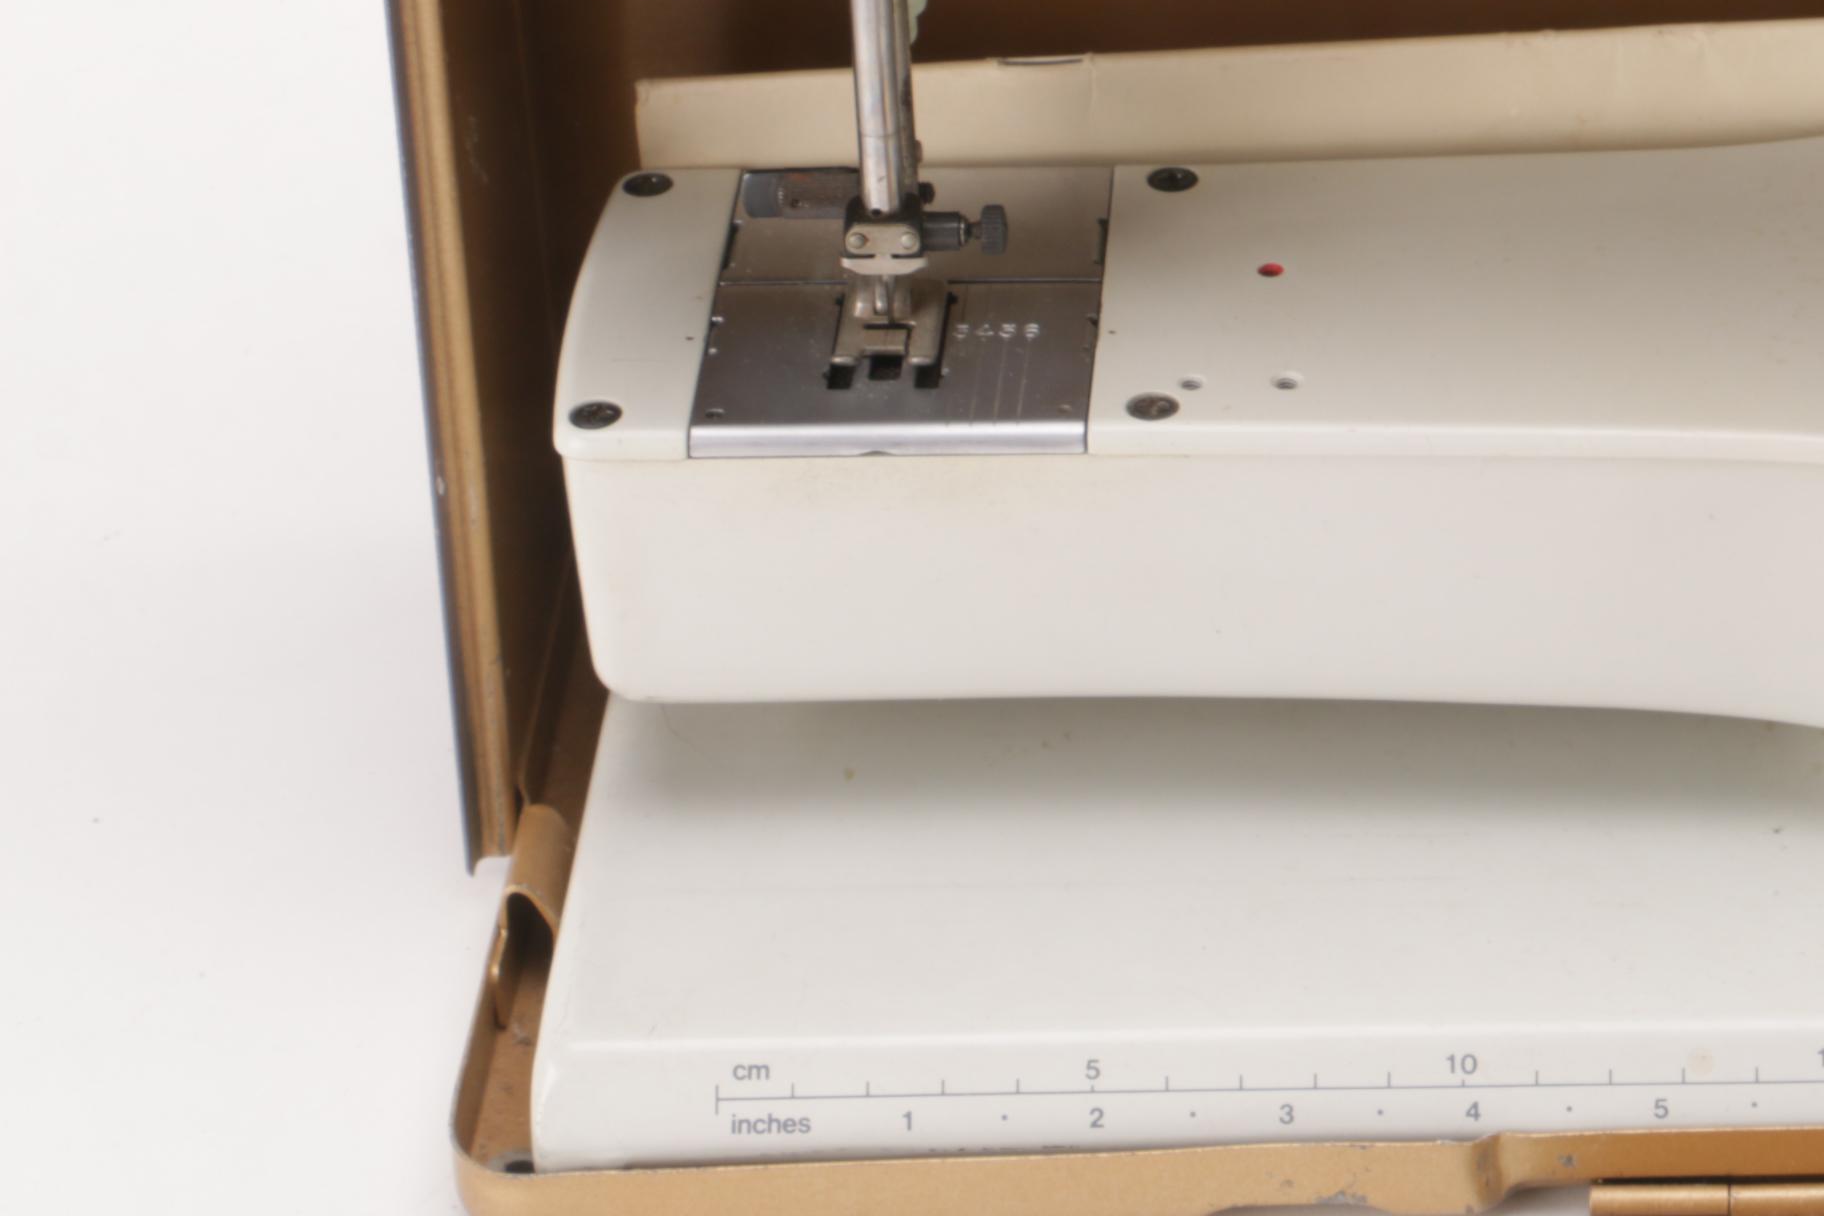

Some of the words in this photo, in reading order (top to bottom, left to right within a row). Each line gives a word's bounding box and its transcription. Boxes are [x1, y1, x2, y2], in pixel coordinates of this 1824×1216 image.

[733, 1065, 770, 1080] cm
[1086, 1059, 1100, 1080] 5
[1447, 1054, 1478, 1075] 10
[730, 1113, 812, 1136] inches
[903, 1112, 912, 1131] 1
[1090, 1108, 1104, 1128] 2
[1280, 1104, 1294, 1125] 3
[1466, 1102, 1480, 1121] 4
[1654, 1099, 1669, 1119] 5
